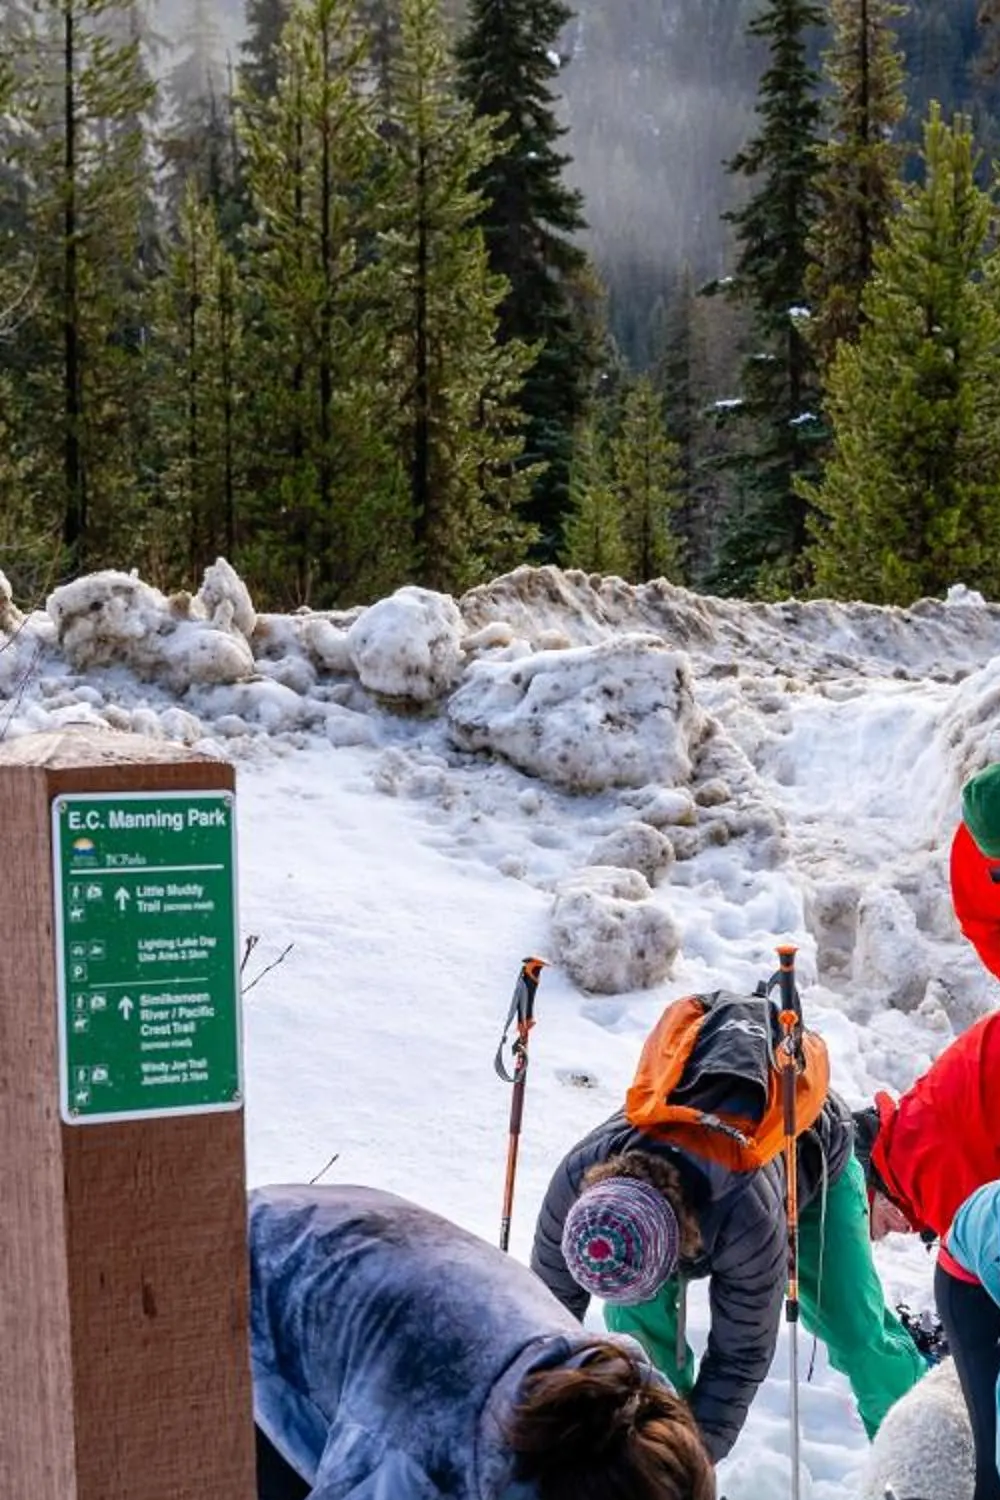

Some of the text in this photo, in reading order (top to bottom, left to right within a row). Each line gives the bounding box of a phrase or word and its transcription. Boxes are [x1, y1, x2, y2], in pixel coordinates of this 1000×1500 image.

[68, 808, 227, 832] E.C. Manning Park
[136, 885, 165, 898] Little
[136, 899, 161, 913] Trail
[140, 1008, 170, 1021] River
[178, 1004, 215, 1018] Pacific
[172, 1021, 196, 1034] Trail
